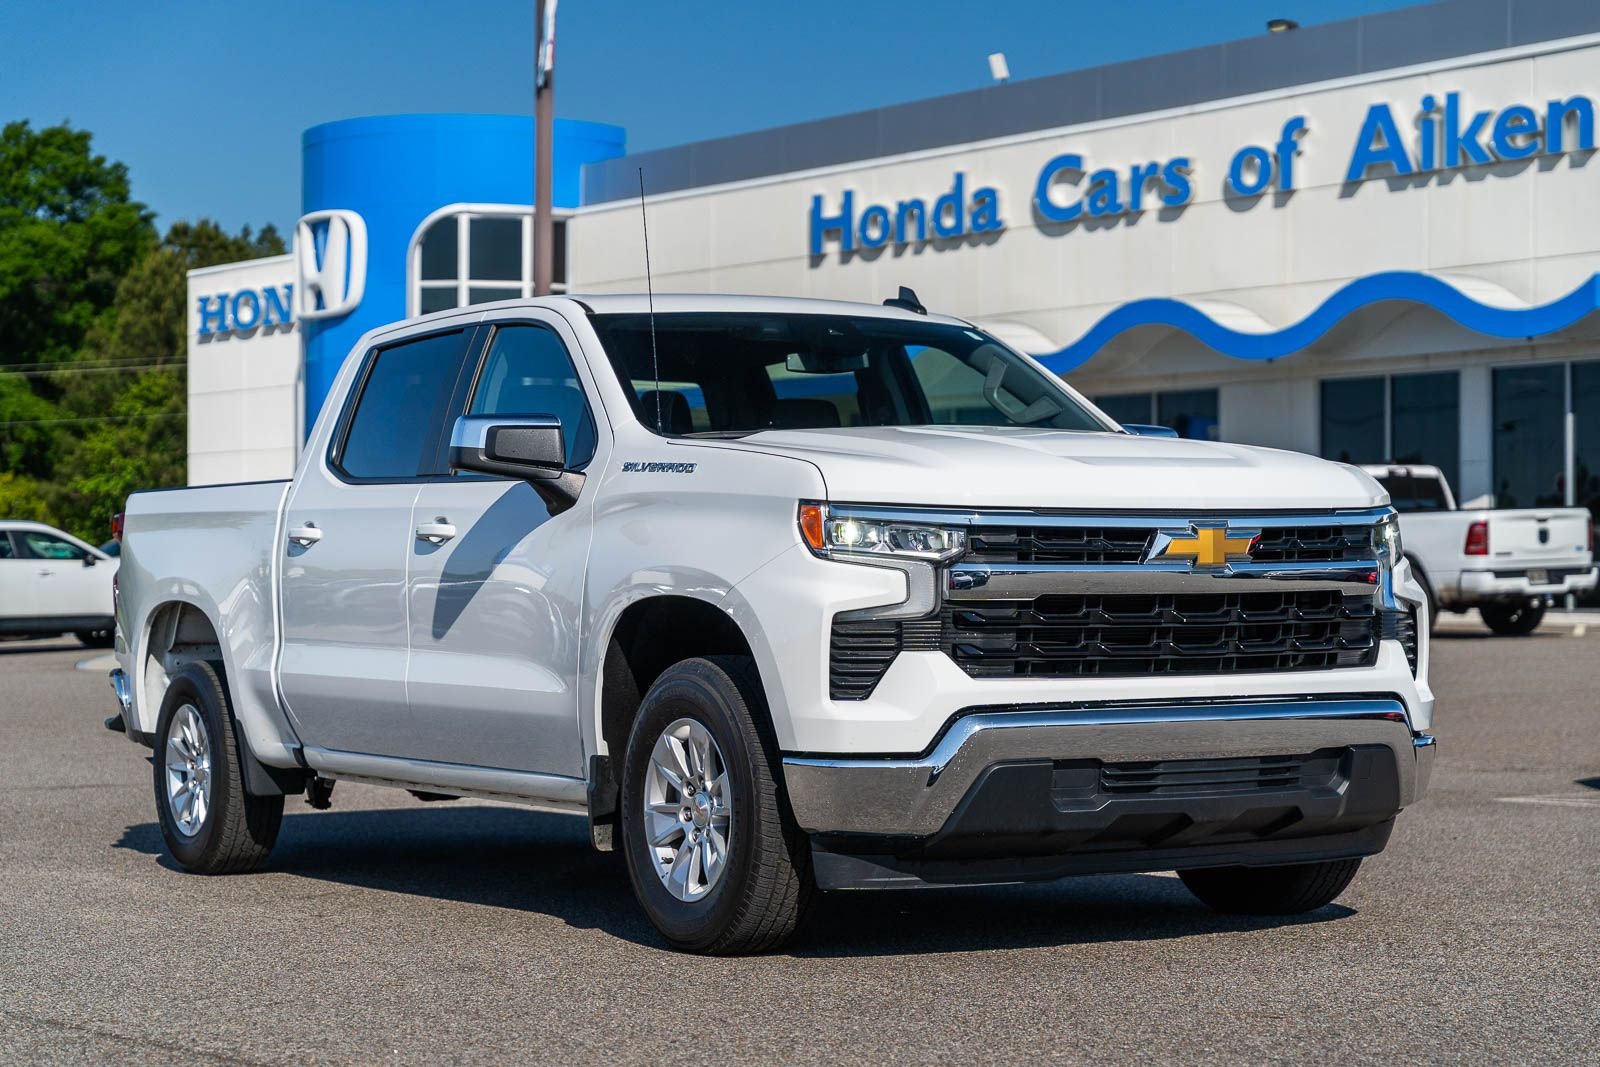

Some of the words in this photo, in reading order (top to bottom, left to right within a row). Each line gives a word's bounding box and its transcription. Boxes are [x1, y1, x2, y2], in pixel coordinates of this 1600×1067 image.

[810, 172, 1003, 256] Honda
[1034, 154, 1191, 223] Cars
[1228, 115, 1306, 197] of
[1346, 91, 1596, 182] Aiken
[198, 283, 294, 336] HON
[622, 462, 697, 473] SILVERADO
